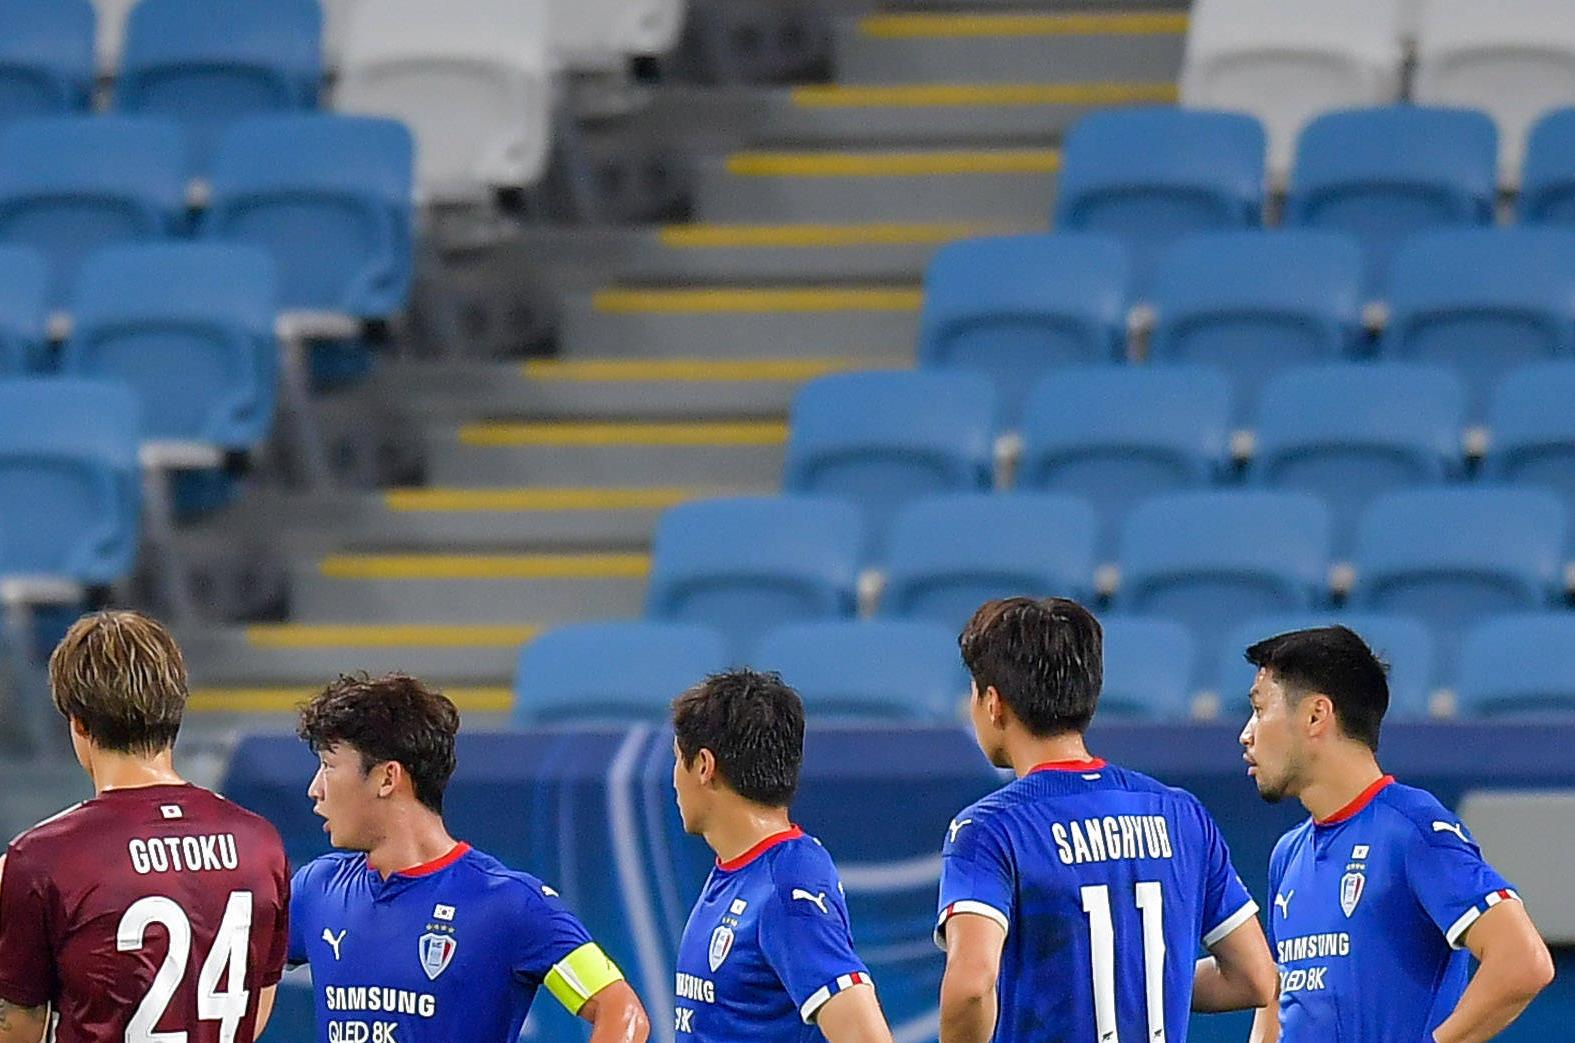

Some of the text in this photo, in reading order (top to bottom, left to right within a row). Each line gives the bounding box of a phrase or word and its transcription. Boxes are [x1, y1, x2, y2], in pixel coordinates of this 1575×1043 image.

[128, 833, 238, 874] GOTOKU
[1051, 815, 1173, 865] SANGHYUB
[1277, 932, 1350, 963] SAMSUNG
[1279, 966, 1328, 992] LED 8K
[325, 985, 436, 1017] SAMSUNG
